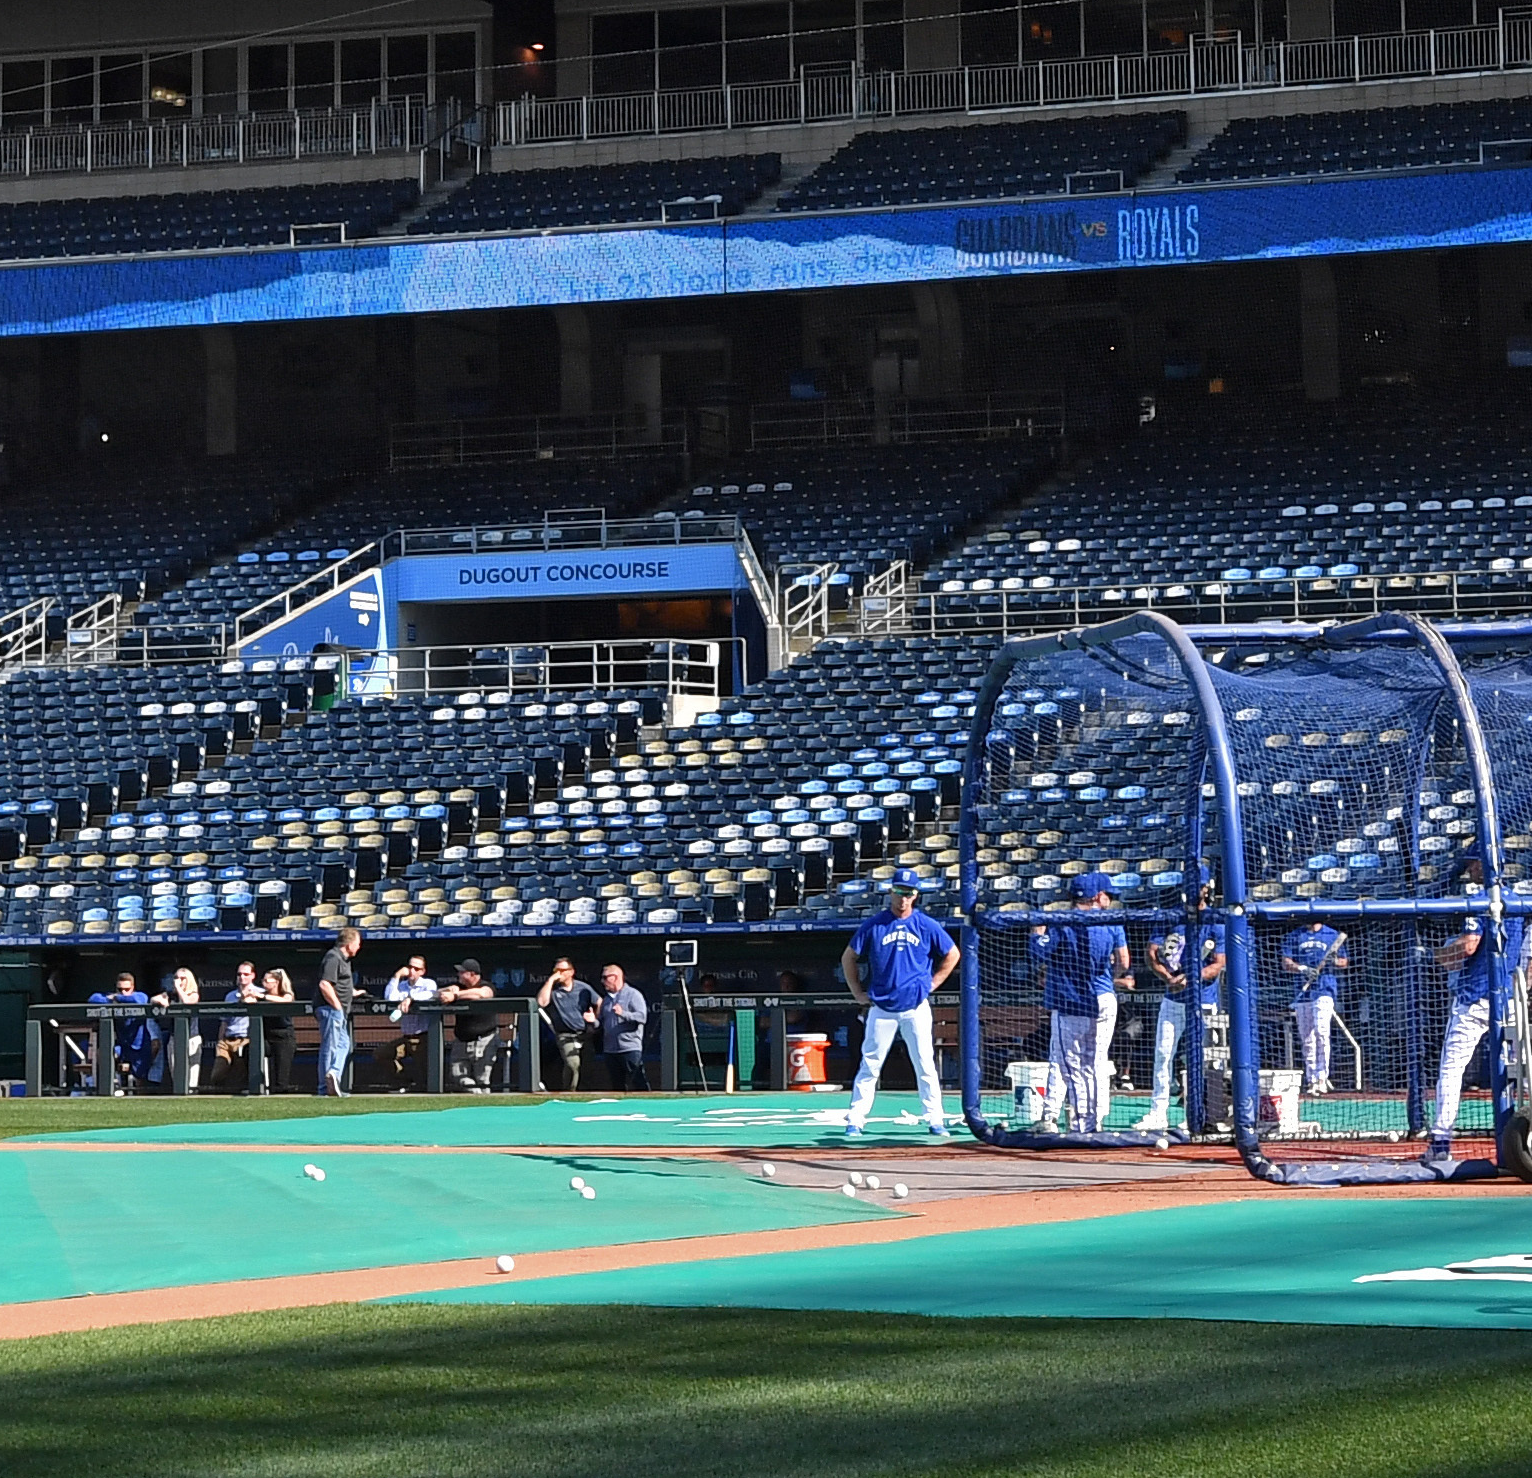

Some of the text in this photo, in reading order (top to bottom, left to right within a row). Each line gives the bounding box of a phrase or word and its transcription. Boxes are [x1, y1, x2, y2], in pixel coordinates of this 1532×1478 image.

[1118, 205, 1199, 261] ROYALS
[853, 244, 935, 274] drove
[459, 561, 669, 585] DUGOUT CONCOURSE
[790, 1049, 805, 1067] G
